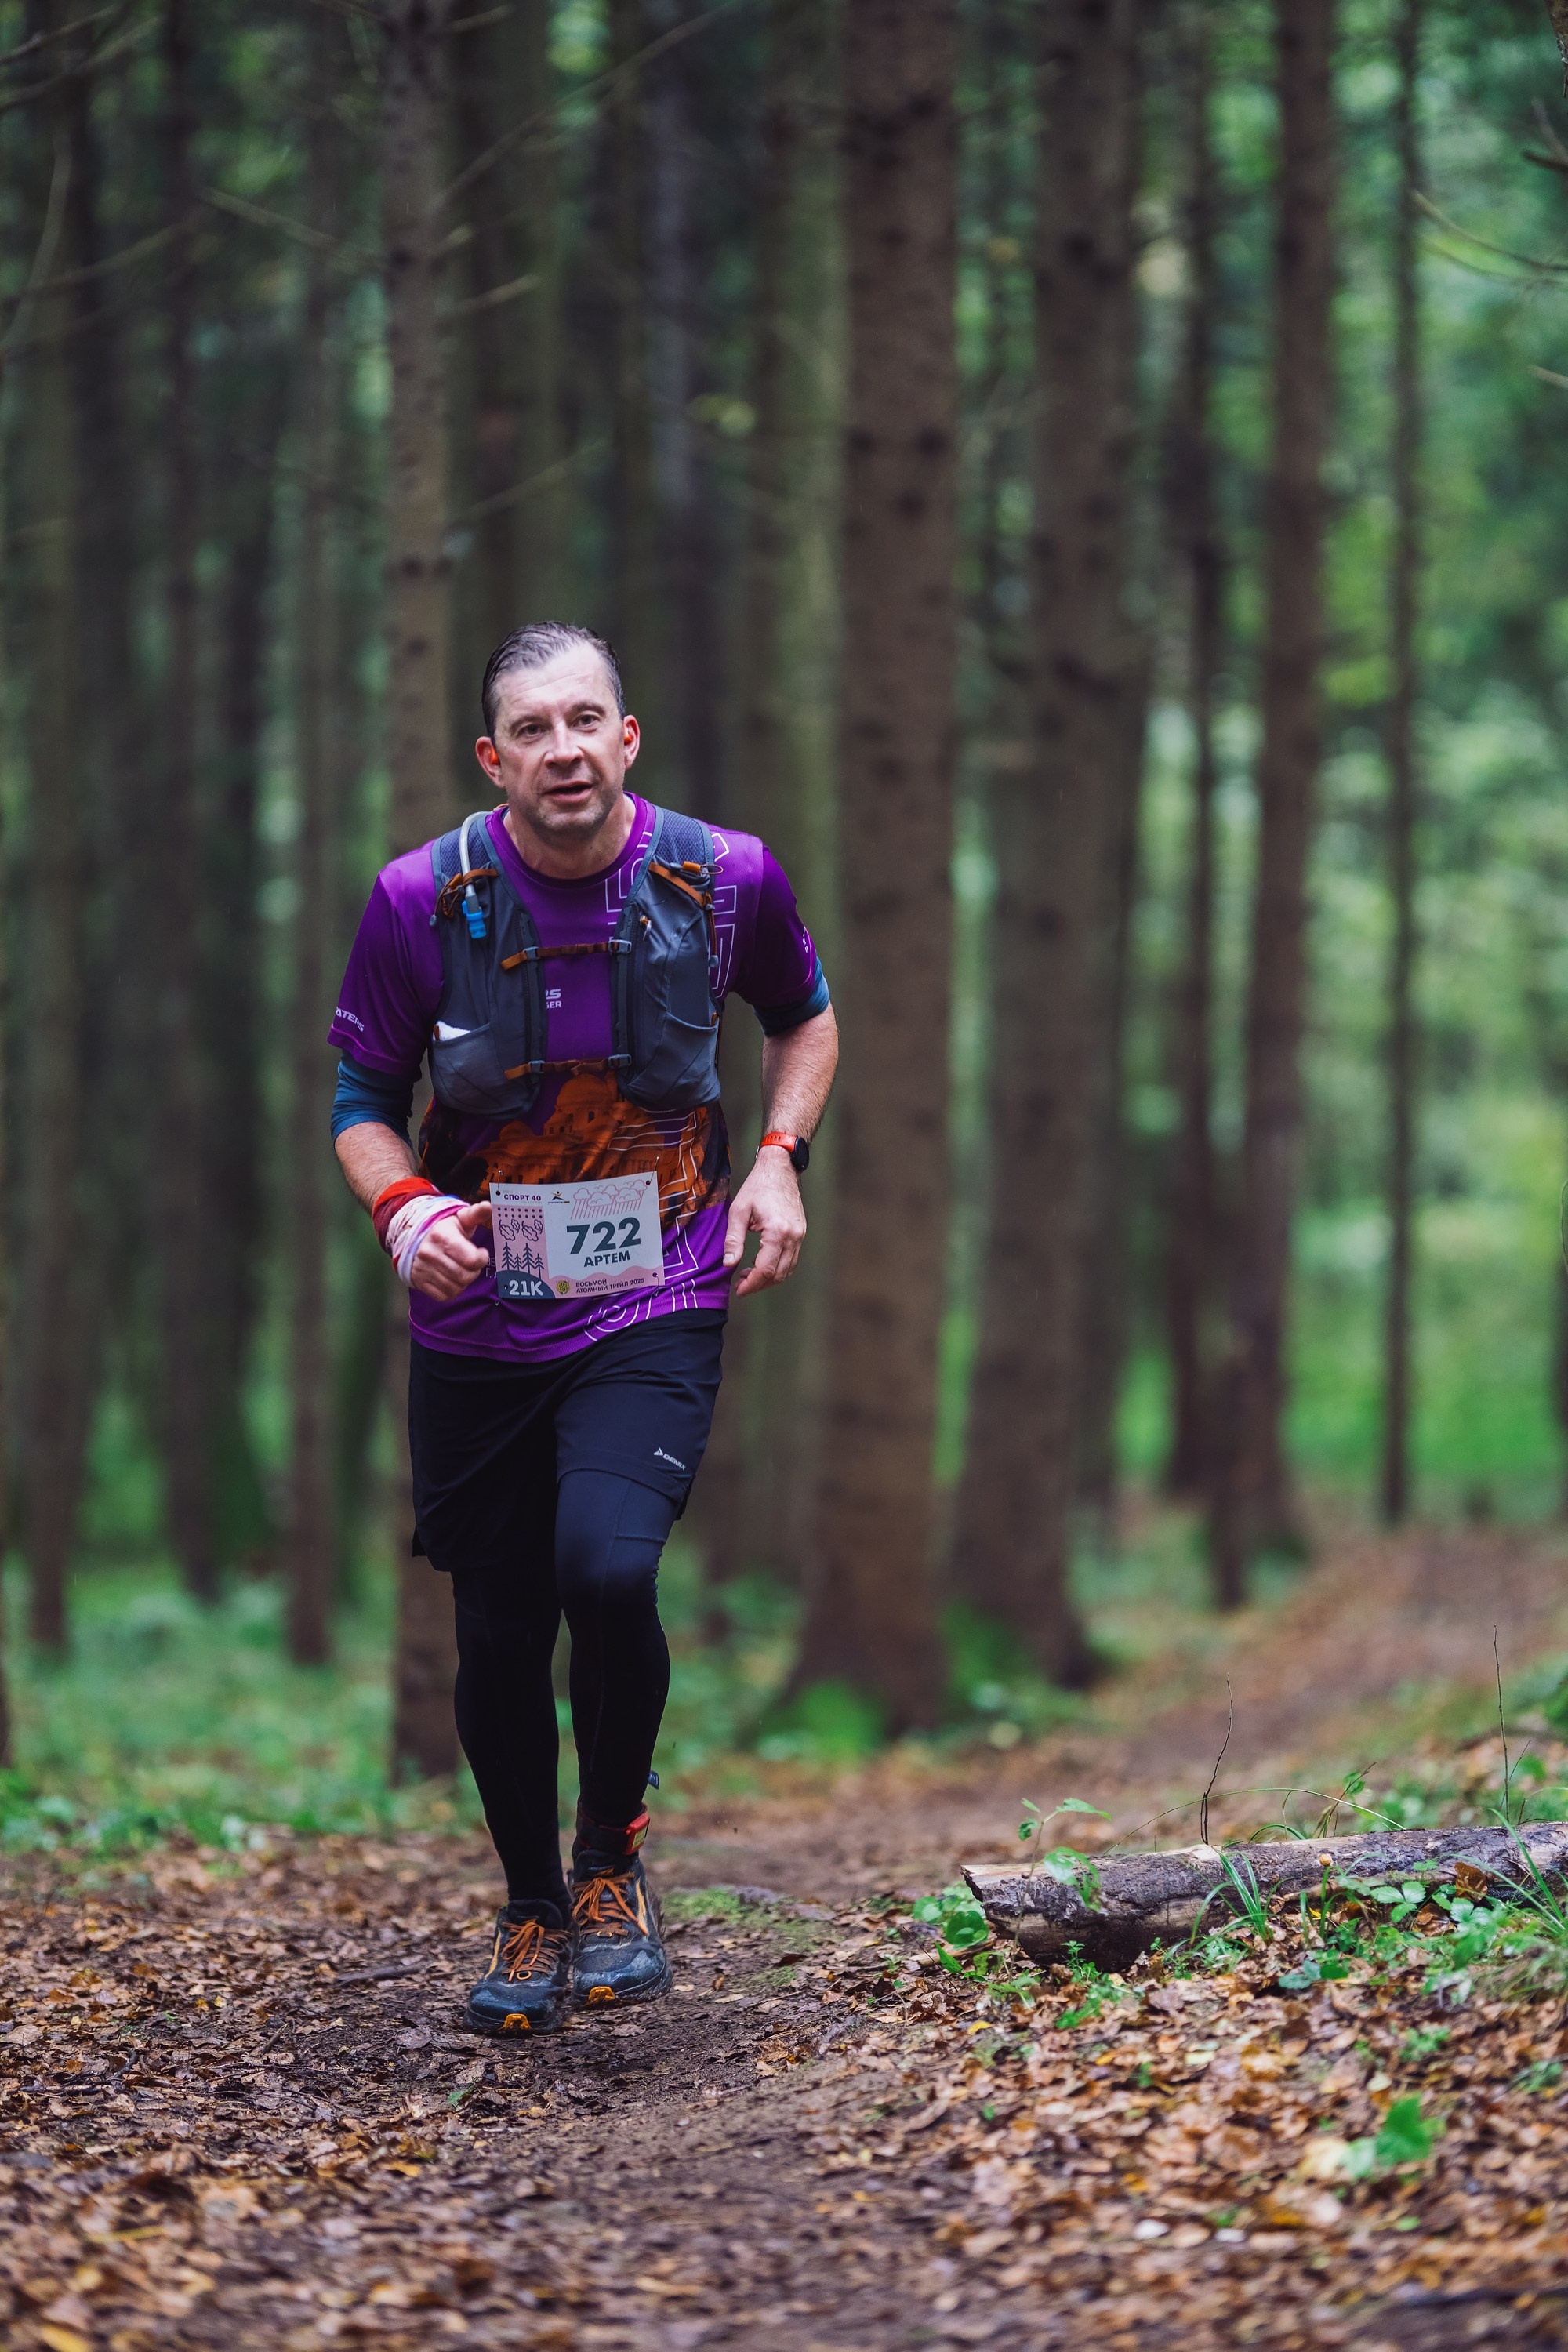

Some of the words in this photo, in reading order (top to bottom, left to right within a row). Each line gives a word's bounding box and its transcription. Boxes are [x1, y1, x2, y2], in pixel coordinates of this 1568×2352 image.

[566, 1217, 641, 1255] 722
[583, 1250, 630, 1268] АРТЕМ
[509, 1279, 543, 1296] 21K
[575, 1278, 607, 1287] ВОСЬМОЙ
[576, 1285, 608, 1294] АТОМНЫЙ
[610, 1281, 629, 1290] ТРЕЙЛ
